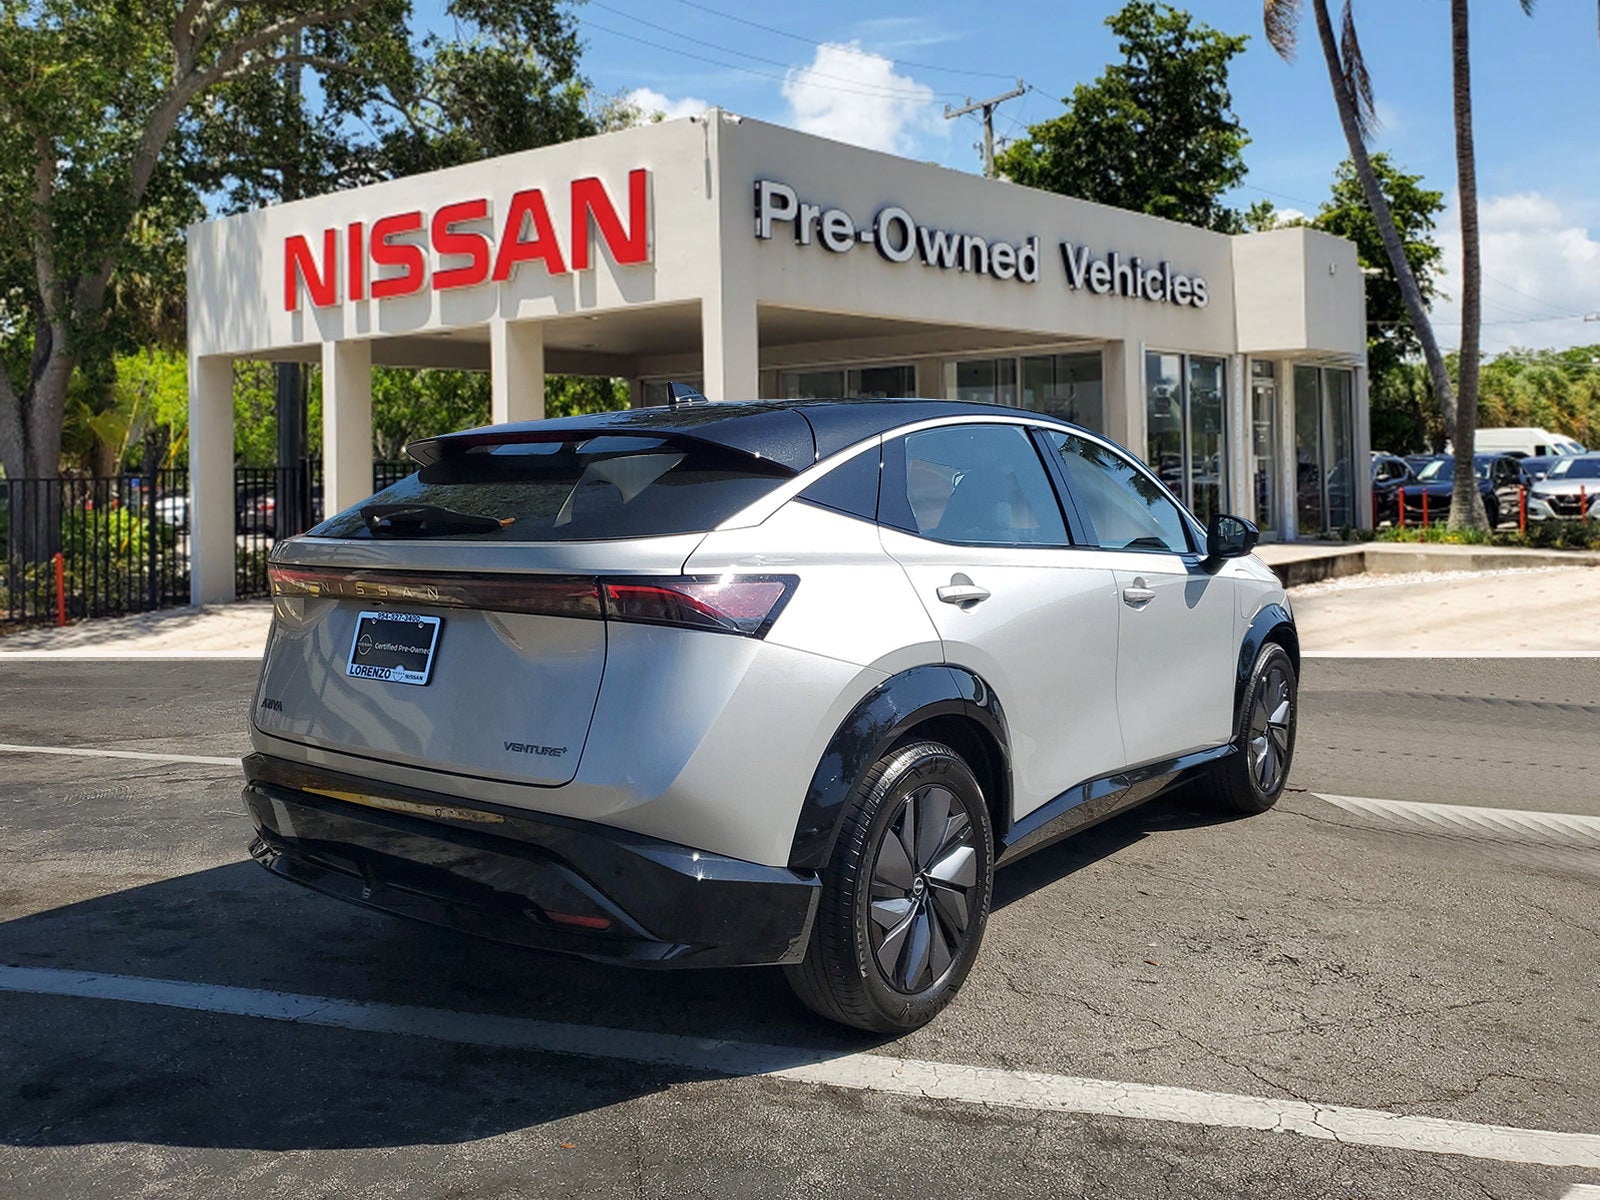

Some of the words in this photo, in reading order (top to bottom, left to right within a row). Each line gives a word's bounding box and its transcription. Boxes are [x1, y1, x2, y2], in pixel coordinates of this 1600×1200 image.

[285, 168, 647, 312] NISSAN
[754, 179, 1041, 284] Pre-Owned
[1060, 241, 1209, 308] Vehicles
[321, 583, 439, 600] NISSAN
[374, 643, 398, 652] Certified
[349, 665, 391, 679] LORENZO
[404, 673, 424, 681] NISSAN
